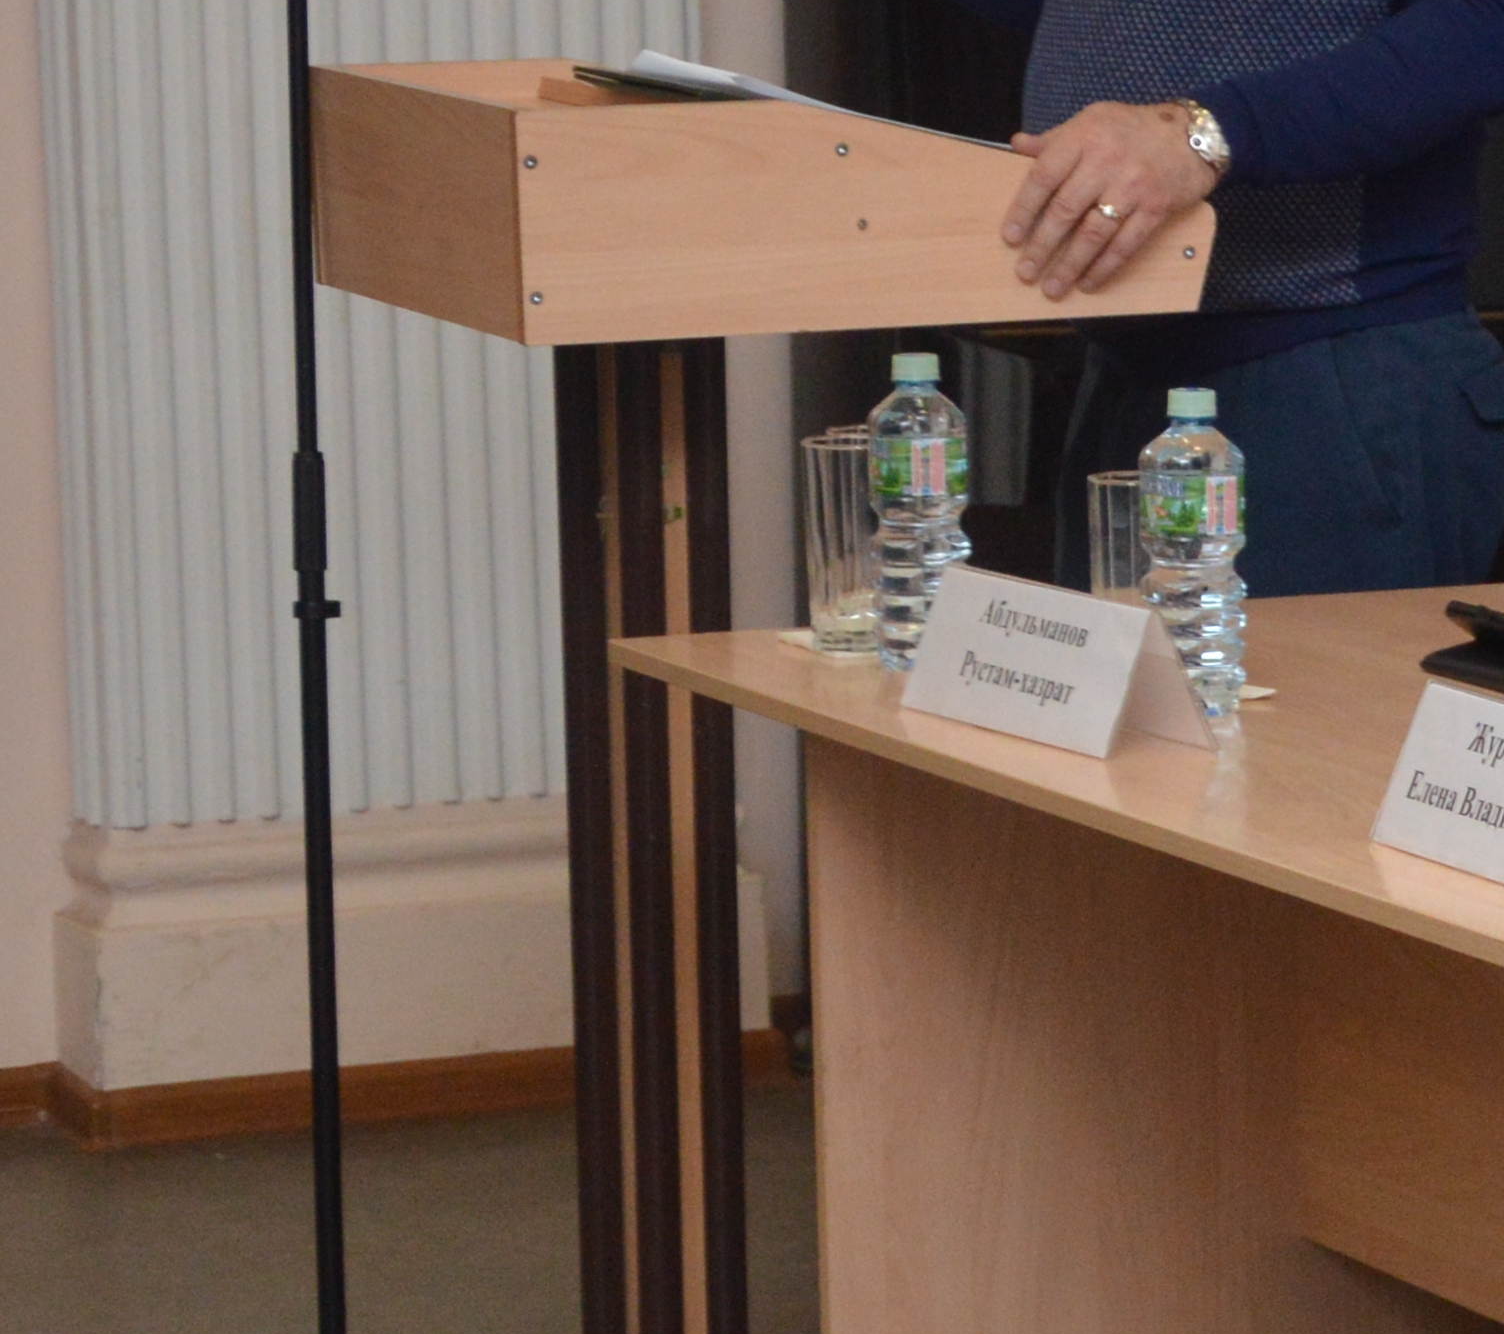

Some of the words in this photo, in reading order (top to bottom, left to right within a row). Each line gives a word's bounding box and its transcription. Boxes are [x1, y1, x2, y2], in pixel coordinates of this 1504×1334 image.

[979, 599, 1089, 648] Абдульманов
[958, 650, 1076, 706] Рустам-хазрат
[1406, 770, 1458, 813] Елена
